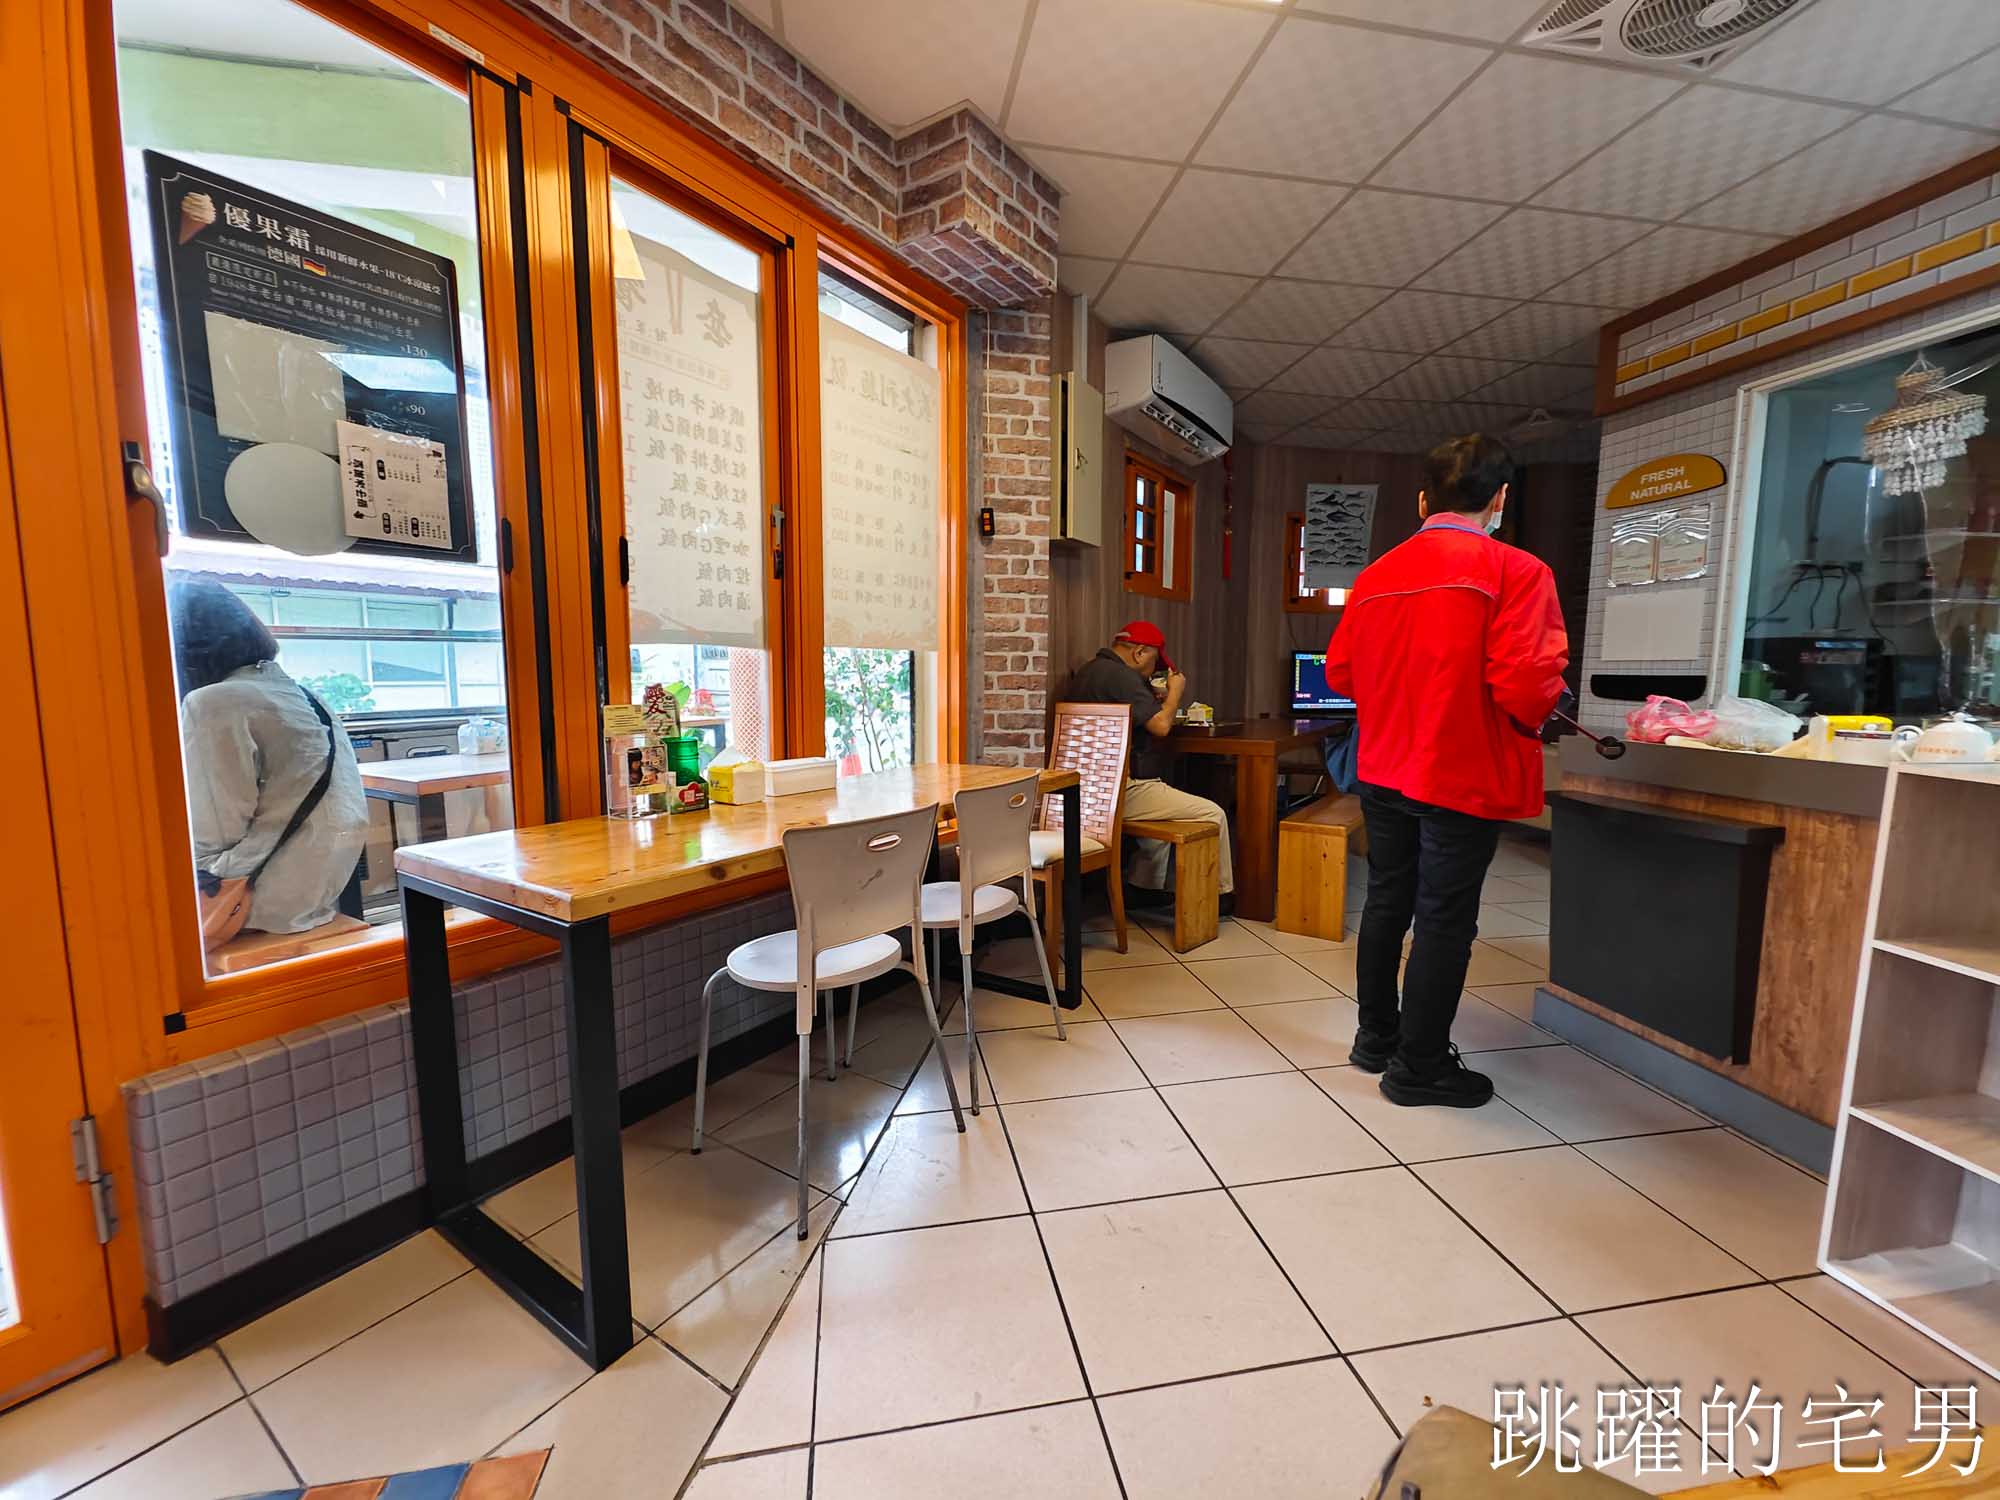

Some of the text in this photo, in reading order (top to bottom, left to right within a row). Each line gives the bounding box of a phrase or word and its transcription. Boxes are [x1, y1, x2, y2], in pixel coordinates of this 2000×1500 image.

[223, 202, 310, 251] 優果霜
[1641, 467, 1684, 484] FRESH
[1631, 480, 1692, 500] NATURAL
